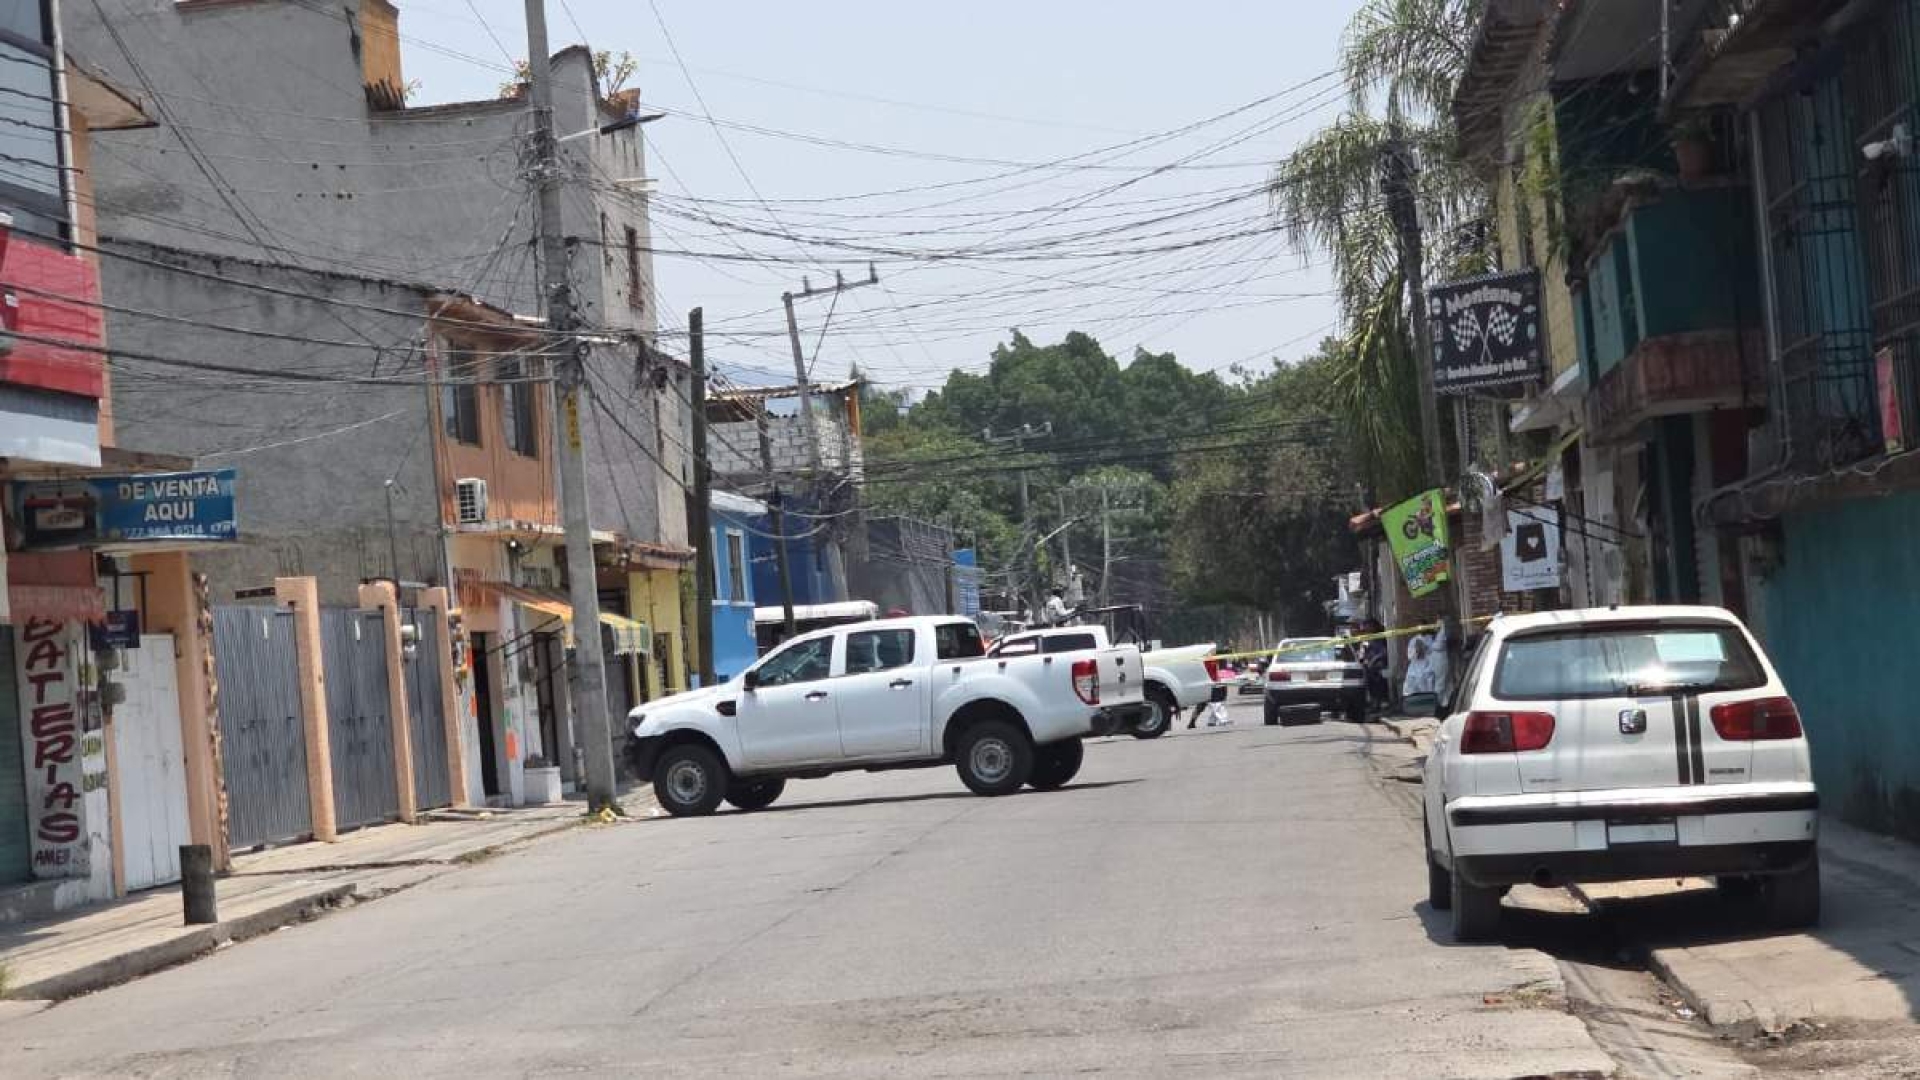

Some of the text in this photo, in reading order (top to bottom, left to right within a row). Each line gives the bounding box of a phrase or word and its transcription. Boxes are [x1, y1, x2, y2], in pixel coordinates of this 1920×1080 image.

[119, 476, 219, 499] DE VENTA
[144, 501, 194, 521] AQUI
